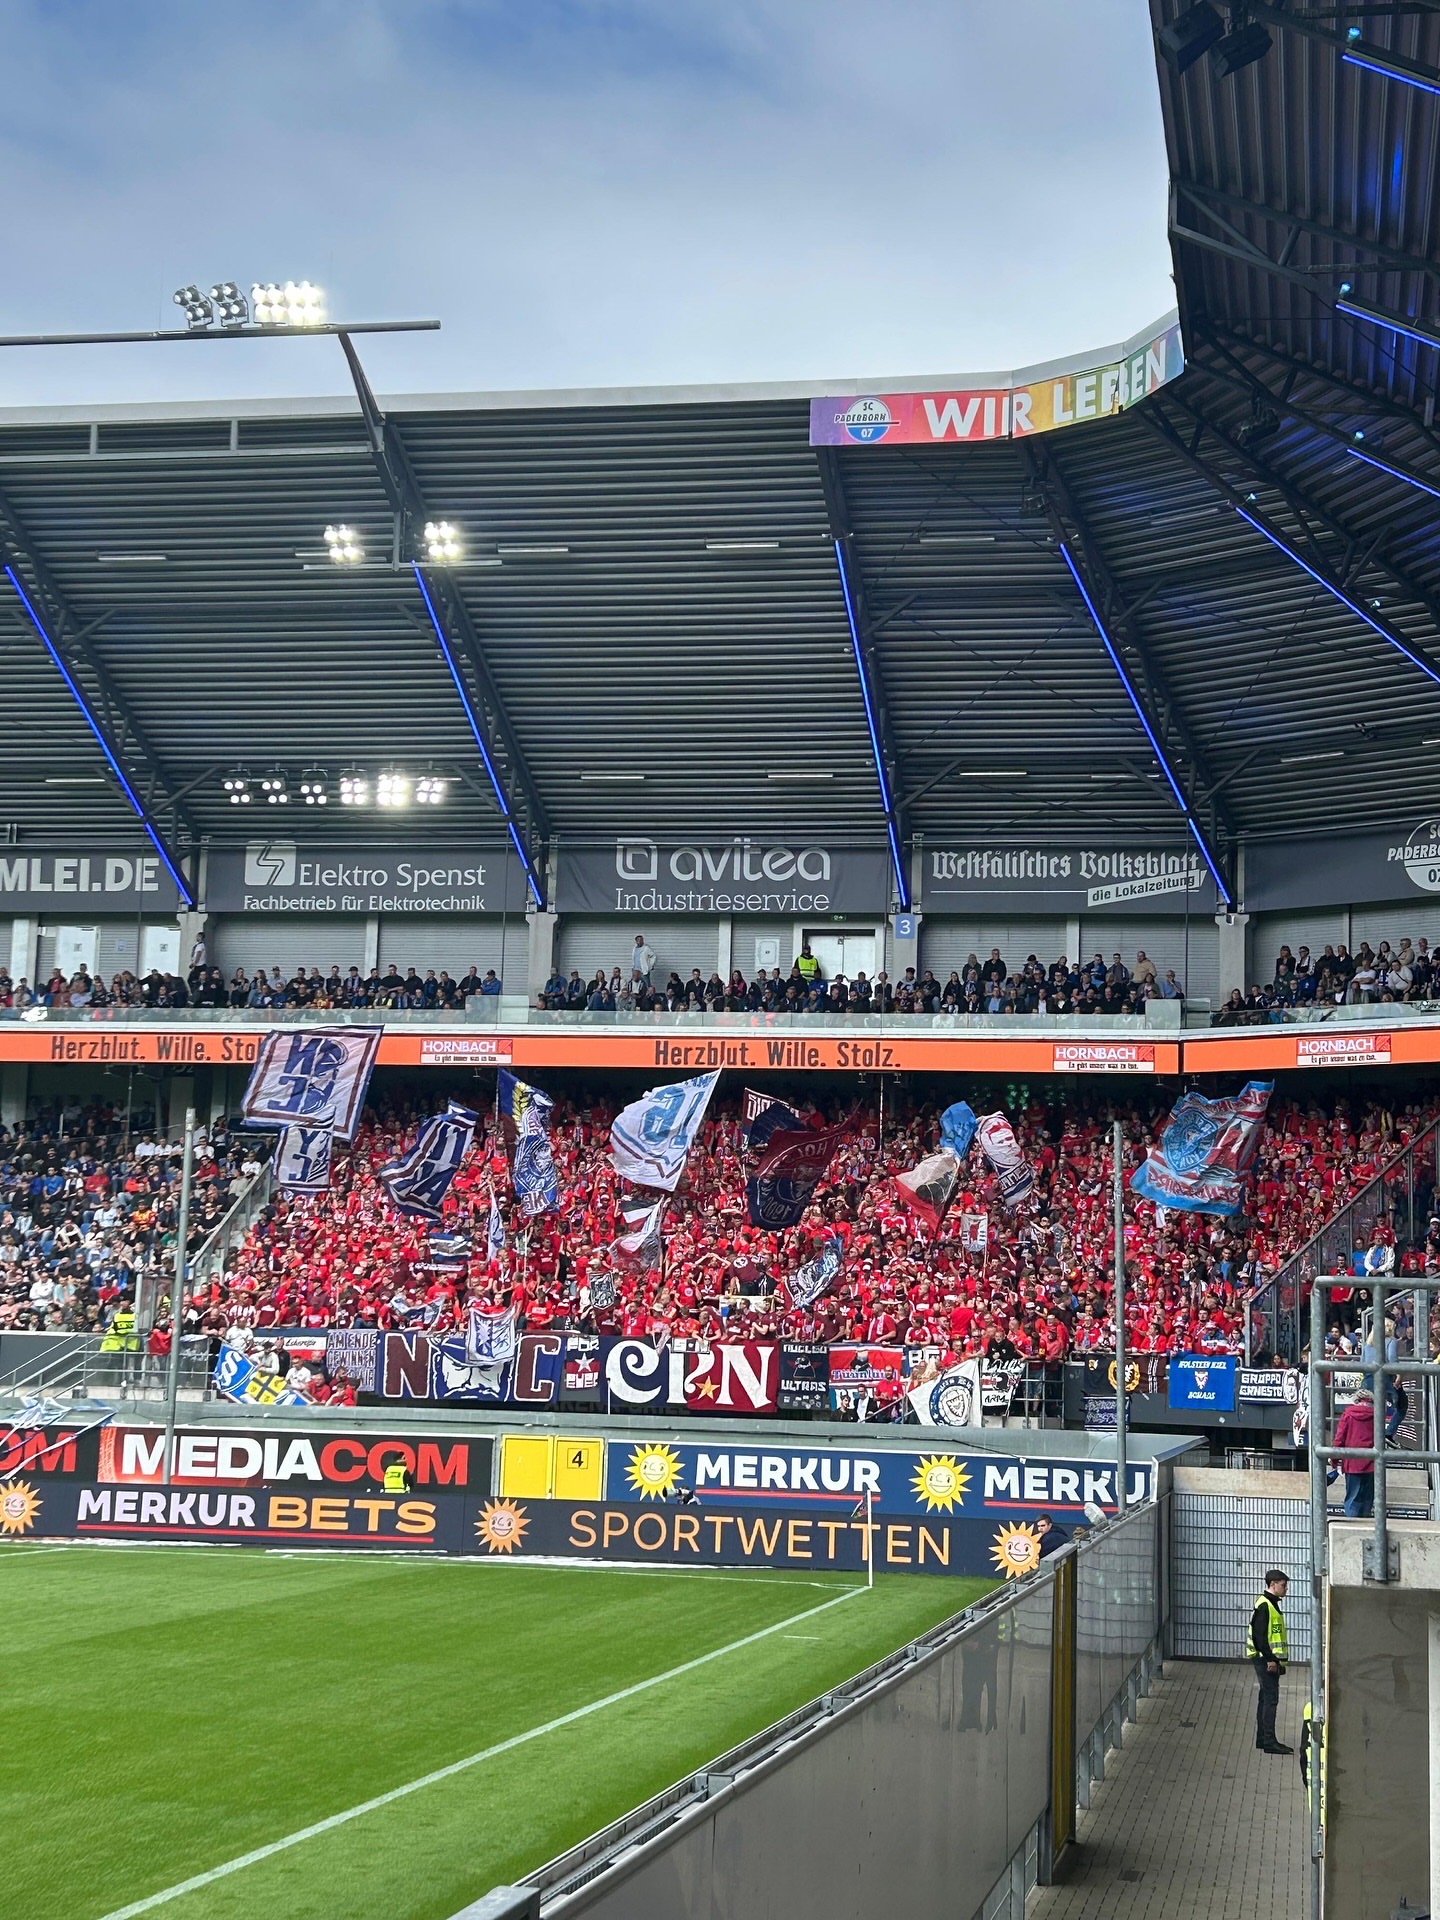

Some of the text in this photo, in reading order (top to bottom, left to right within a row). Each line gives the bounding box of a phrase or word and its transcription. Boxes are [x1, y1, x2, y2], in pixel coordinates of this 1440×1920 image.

[922, 339, 1166, 438] WIR LEBEN
[863, 402, 874, 411] SC
[834, 413, 886, 422] PADERBORN
[860, 428, 874, 438] 07
[1429, 824, 1440, 839] S
[669, 838, 831, 882] avitea
[1387, 844, 1440, 861] PADERB
[299, 863, 486, 892] Elektro Spenst
[1428, 868, 1440, 883] 0
[1092, 873, 1196, 903] die Lokalzeitung
[243, 895, 485, 911] Fachbetrieb für Elektrotechnik
[614, 888, 830, 912] Industrieservice
[900, 918, 911, 936] 3
[51, 1036, 145, 1061] Herzblut.
[157, 1036, 211, 1061] Wille.
[423, 1040, 496, 1052] HORNBACH
[655, 1041, 901, 1067] Herzblut. Wille. Stolz.
[1055, 1047, 1137, 1060] HORNBACH
[1298, 1037, 1374, 1054] HORNBACH
[566, 1336, 600, 1352] FOR
[1178, 1360, 1211, 1369] HOLSTEIN
[780, 1379, 826, 1392] ULTRAS
[122, 1433, 469, 1486] MEDIACOM
[570, 1450, 583, 1469] 4
[697, 1452, 880, 1493] MERKUR
[984, 1463, 1153, 1504] MERKU
[77, 1489, 437, 1534] MERKUR BETS
[569, 1509, 951, 1567] SPORTWETTEN
